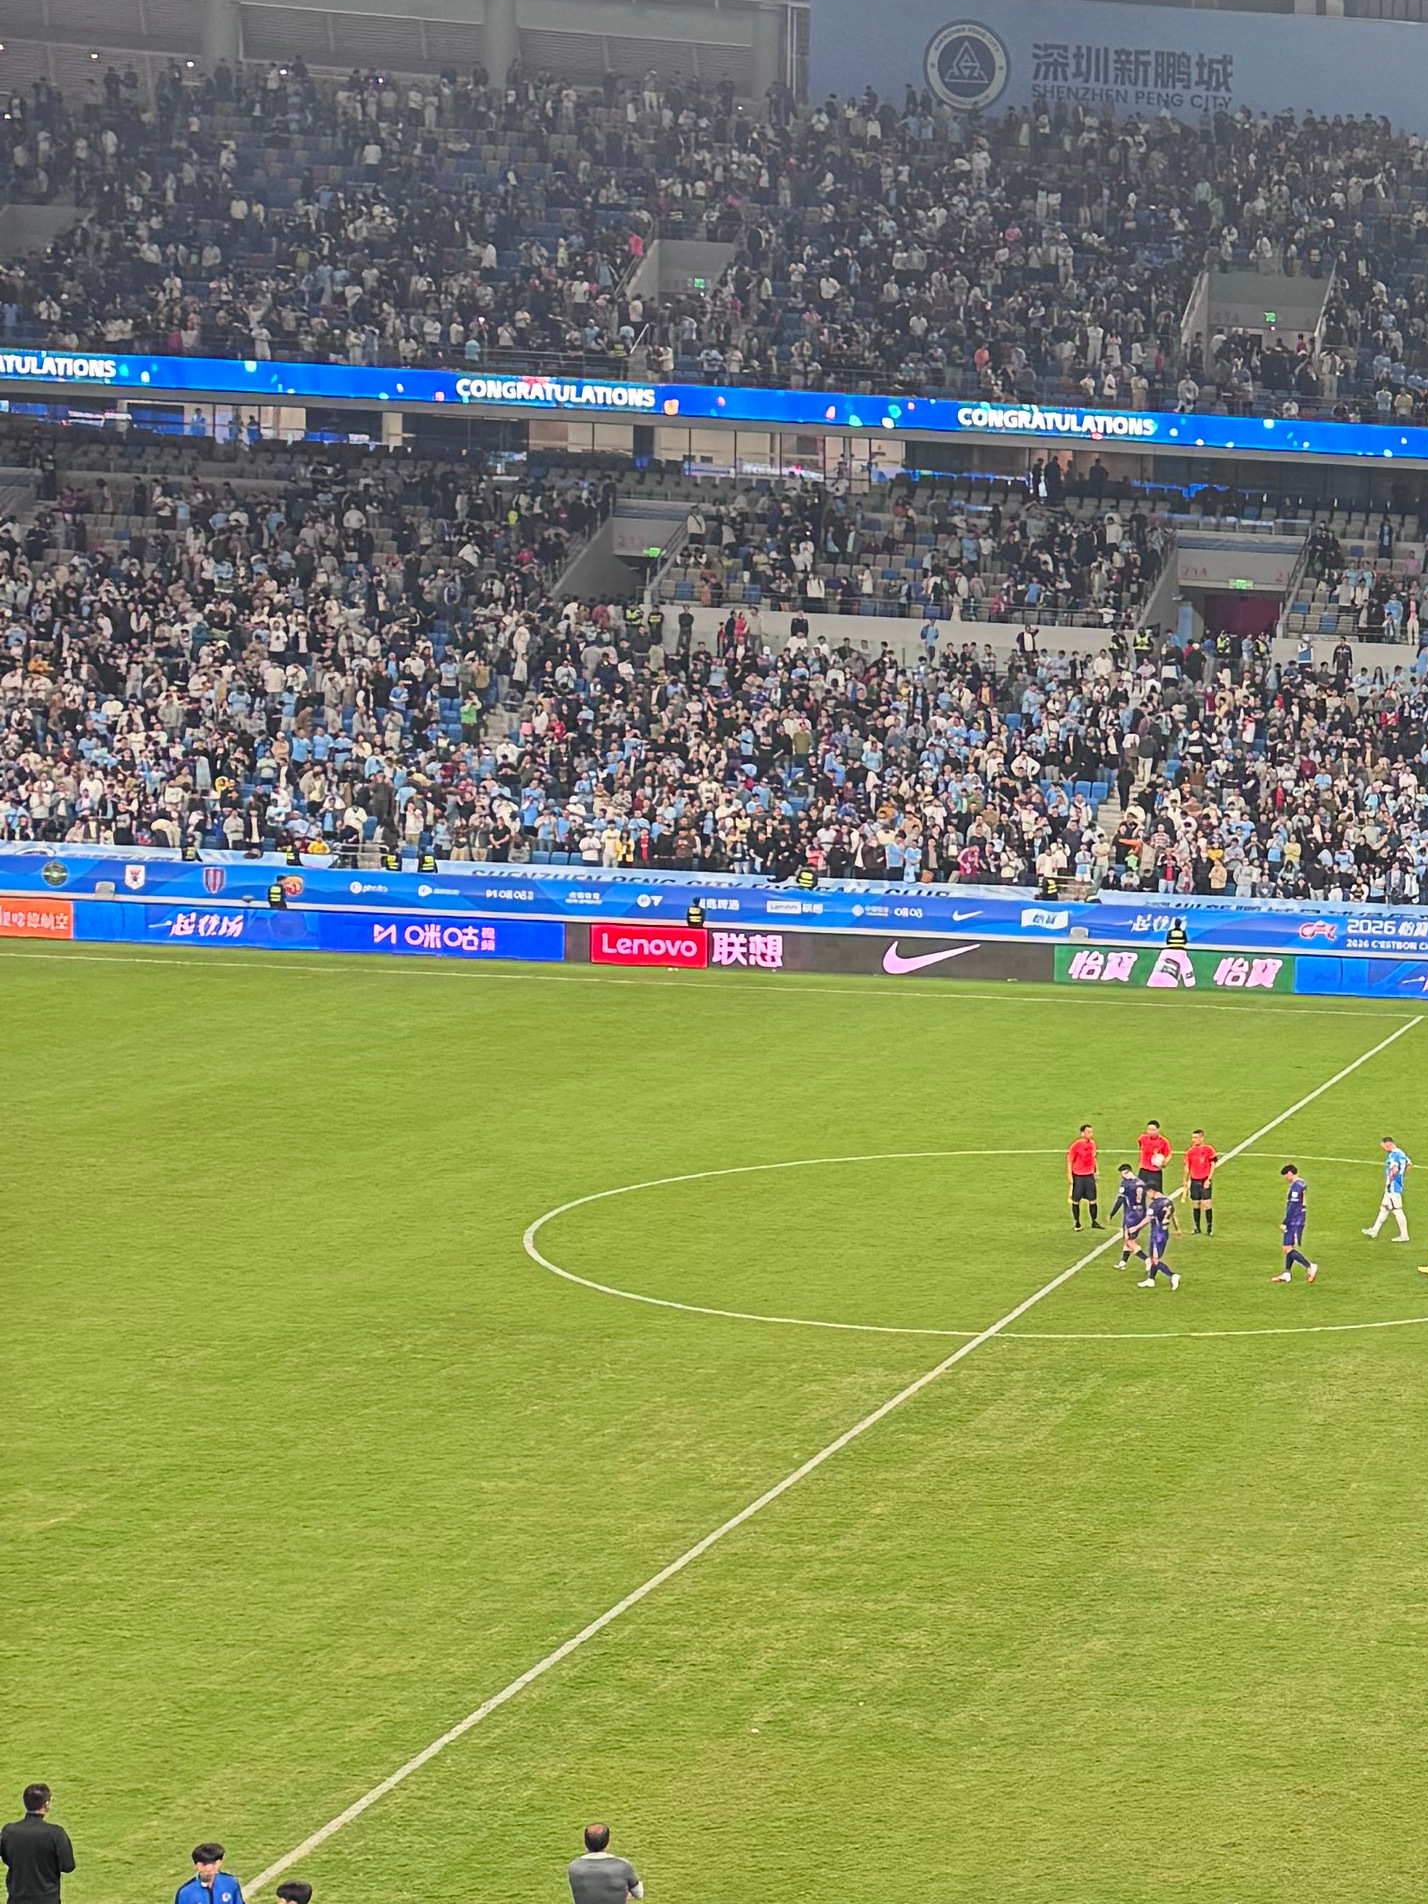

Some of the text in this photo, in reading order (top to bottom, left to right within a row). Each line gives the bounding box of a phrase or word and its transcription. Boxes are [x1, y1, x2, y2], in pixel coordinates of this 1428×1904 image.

[1032, 43, 1234, 93] 深圳新鹏城
[1135, 90, 1184, 108] PENG
[456, 378, 656, 408] CONGRATULATIONS
[957, 407, 1155, 437] CONGRATULATIONS
[602, 932, 698, 958] Lenovo
[712, 931, 784, 968] 联想
